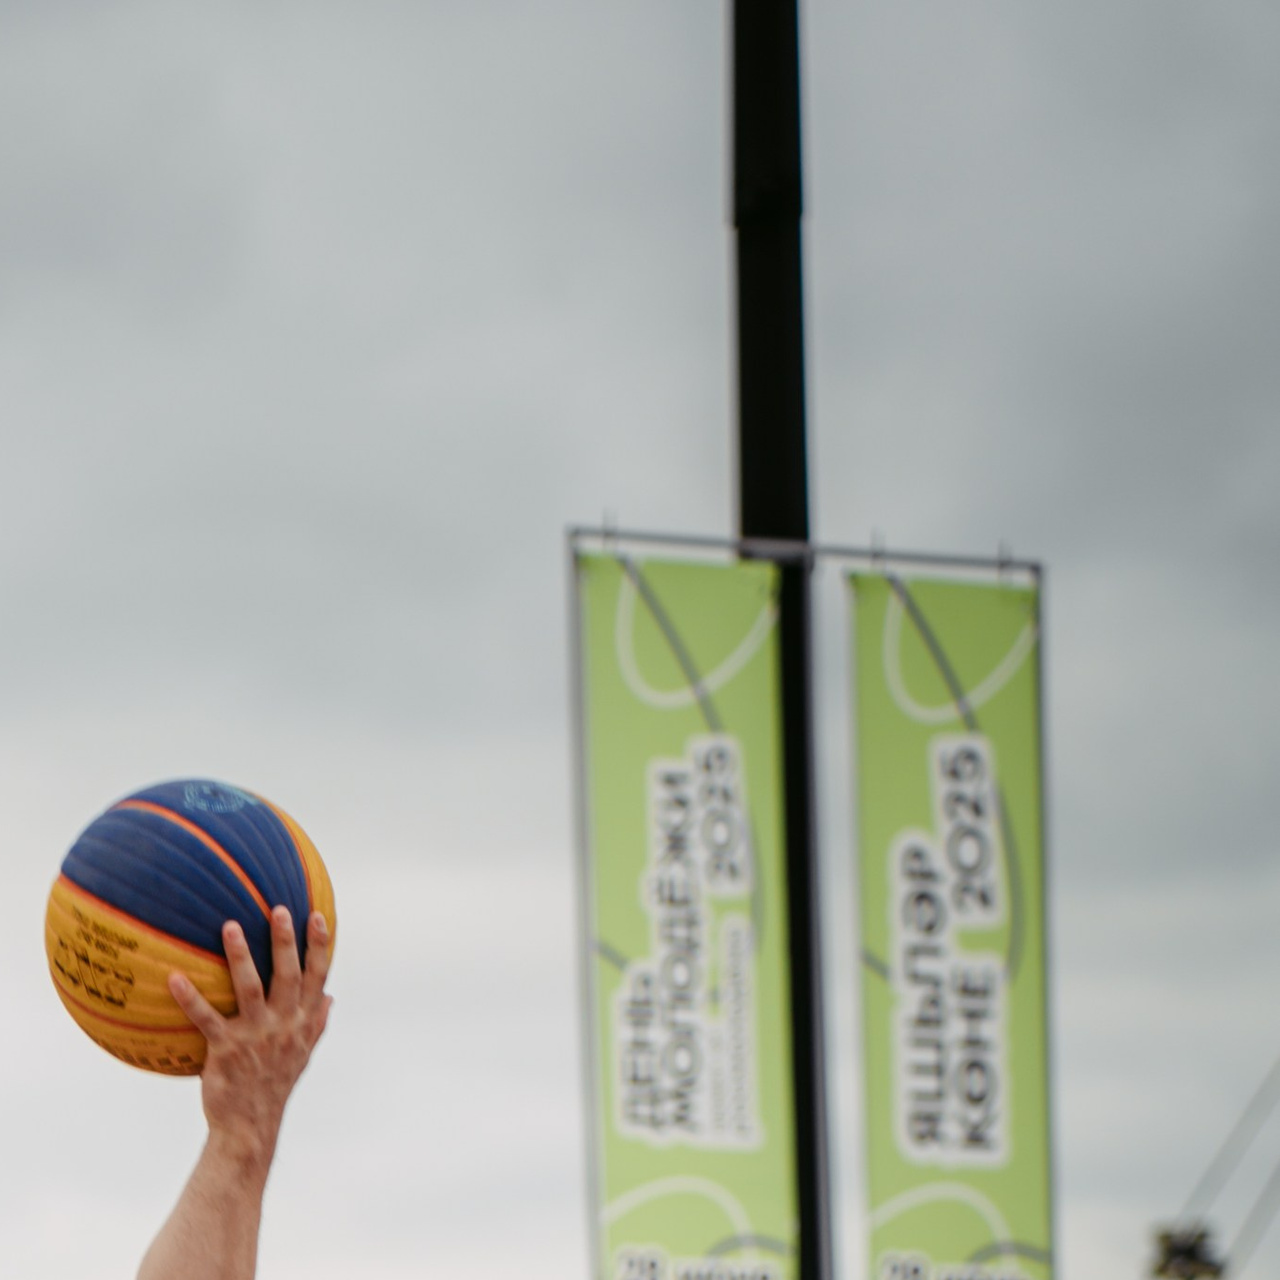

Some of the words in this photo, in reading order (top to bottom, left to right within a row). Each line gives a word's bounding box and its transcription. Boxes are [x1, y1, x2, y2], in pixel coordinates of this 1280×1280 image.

[698, 745, 740, 883] 2025
[939, 747, 995, 911] 2025
[619, 973, 664, 1130] ДЕНЬ
